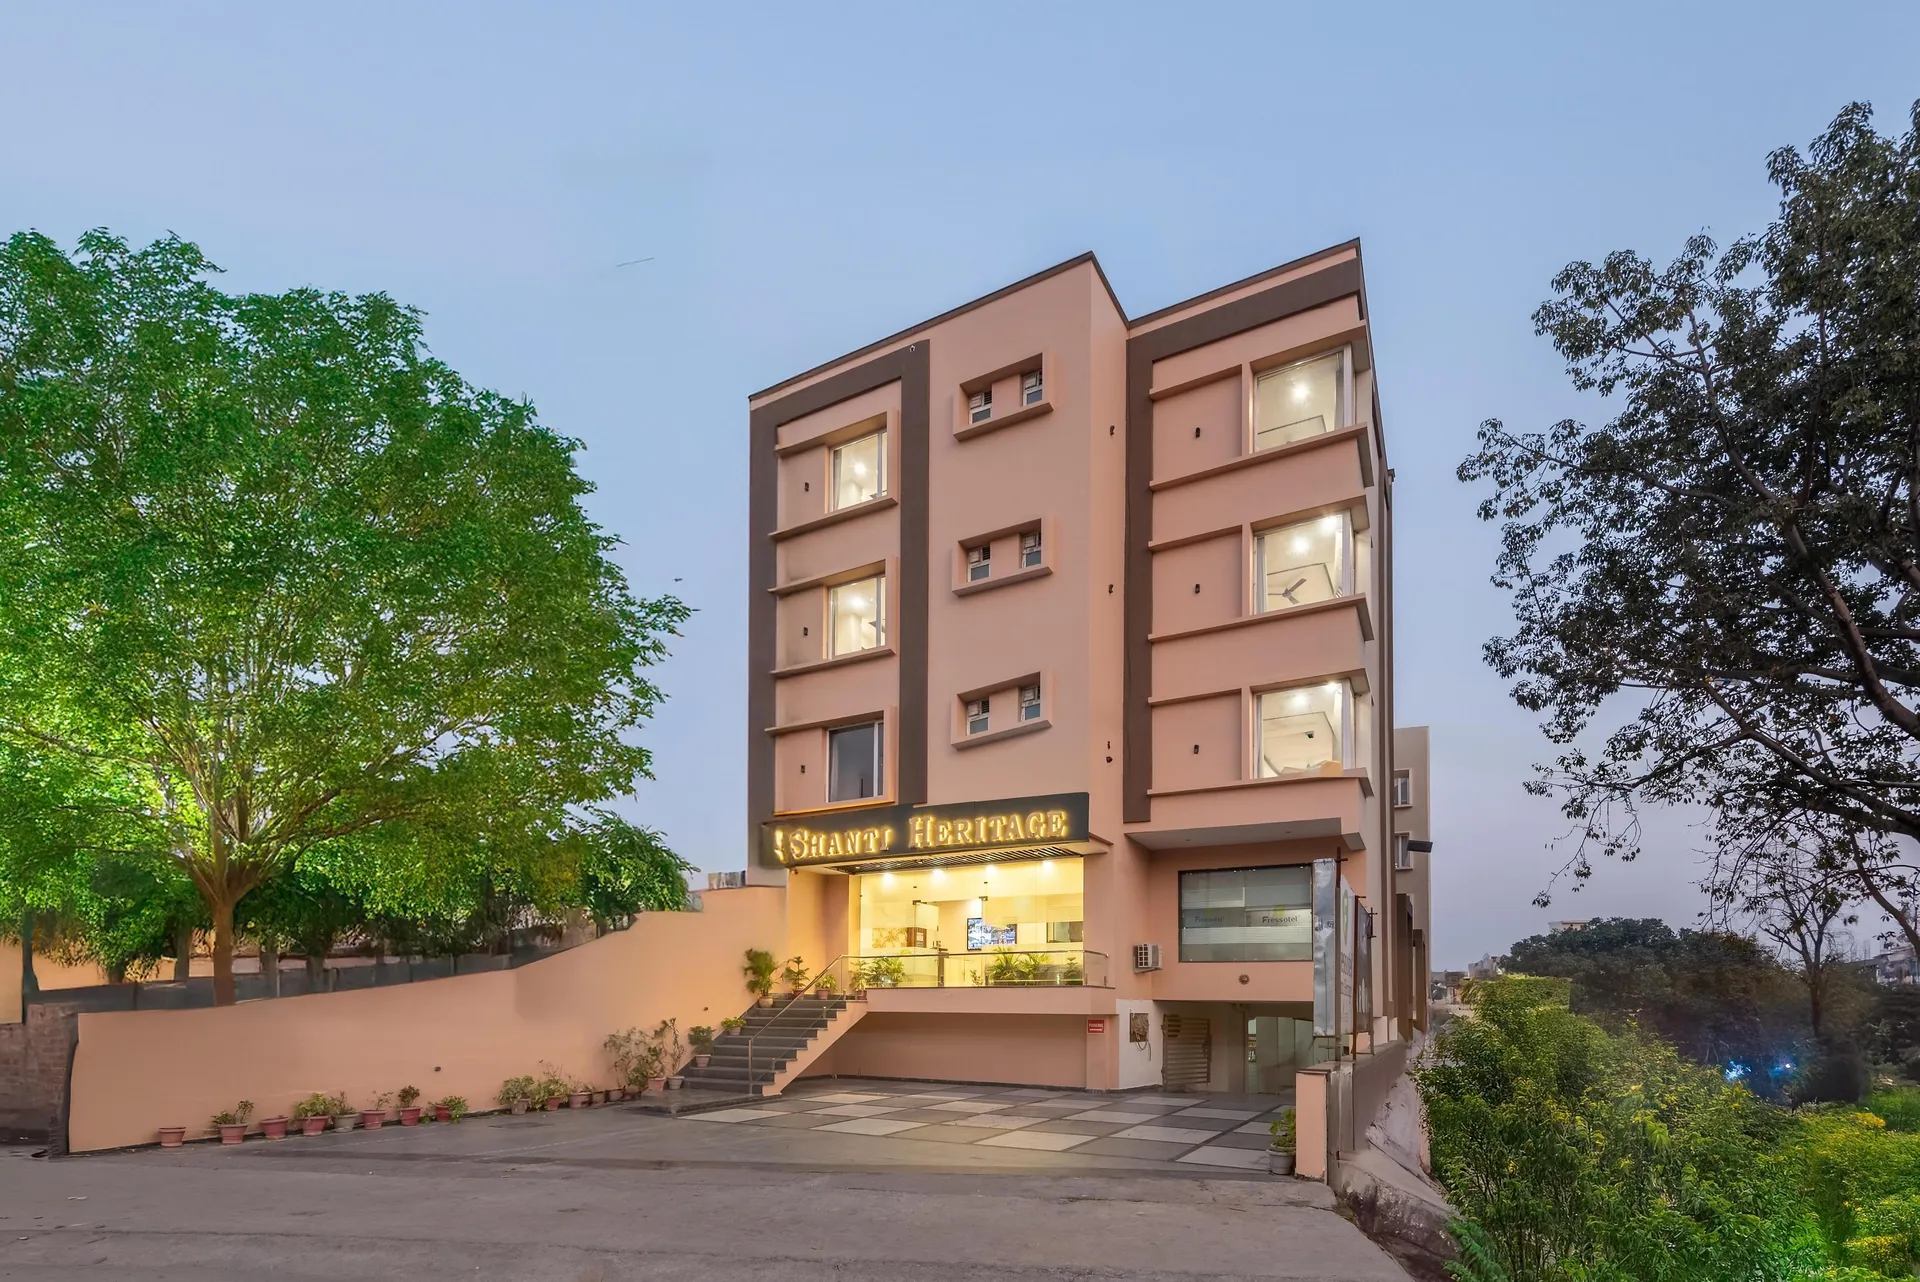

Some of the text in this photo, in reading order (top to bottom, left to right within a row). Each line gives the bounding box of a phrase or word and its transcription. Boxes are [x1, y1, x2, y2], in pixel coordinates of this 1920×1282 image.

[789, 810, 1067, 859] SHANTI HERITAGE
[1261, 915, 1298, 924] Fressotel
